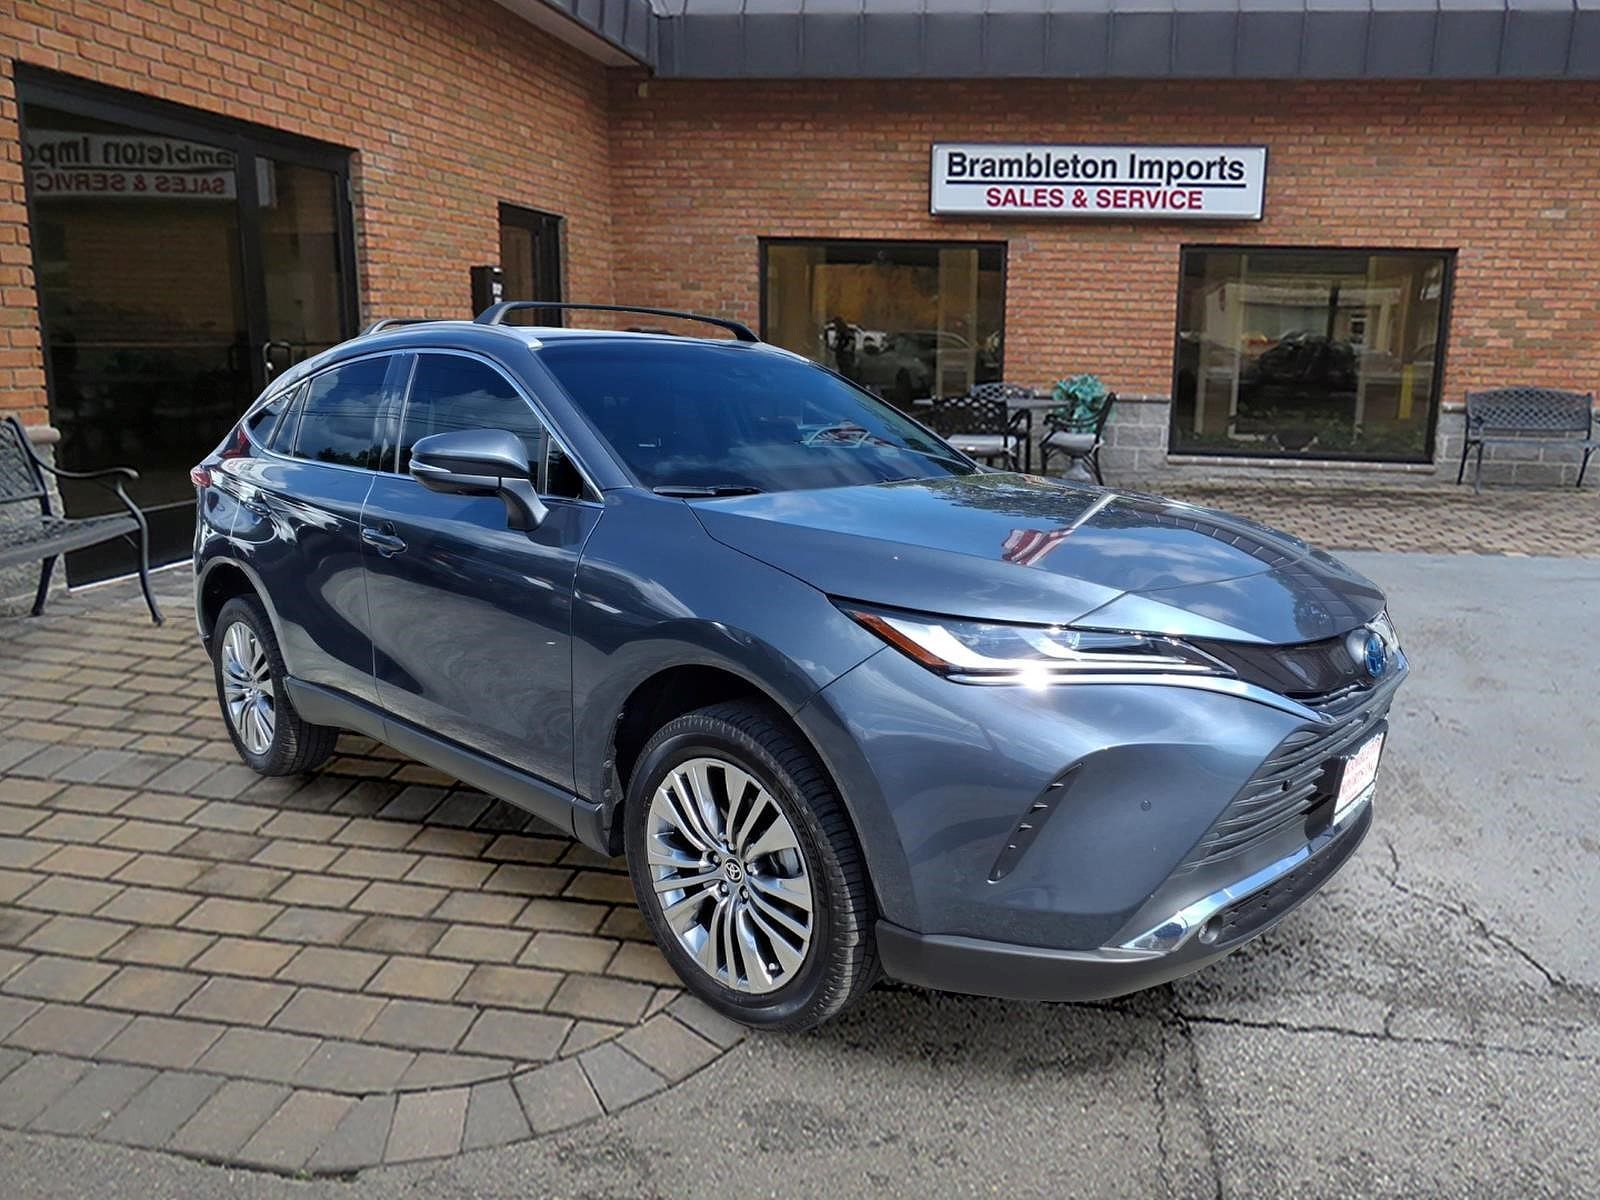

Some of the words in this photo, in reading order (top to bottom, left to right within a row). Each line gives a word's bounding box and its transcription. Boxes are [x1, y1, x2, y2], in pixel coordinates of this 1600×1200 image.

[947, 151, 1118, 180] Brambleton
[1128, 153, 1246, 187] Imports
[986, 187, 1064, 208] SALES
[1072, 188, 1088, 208] &
[1096, 189, 1203, 210] SERVICE
